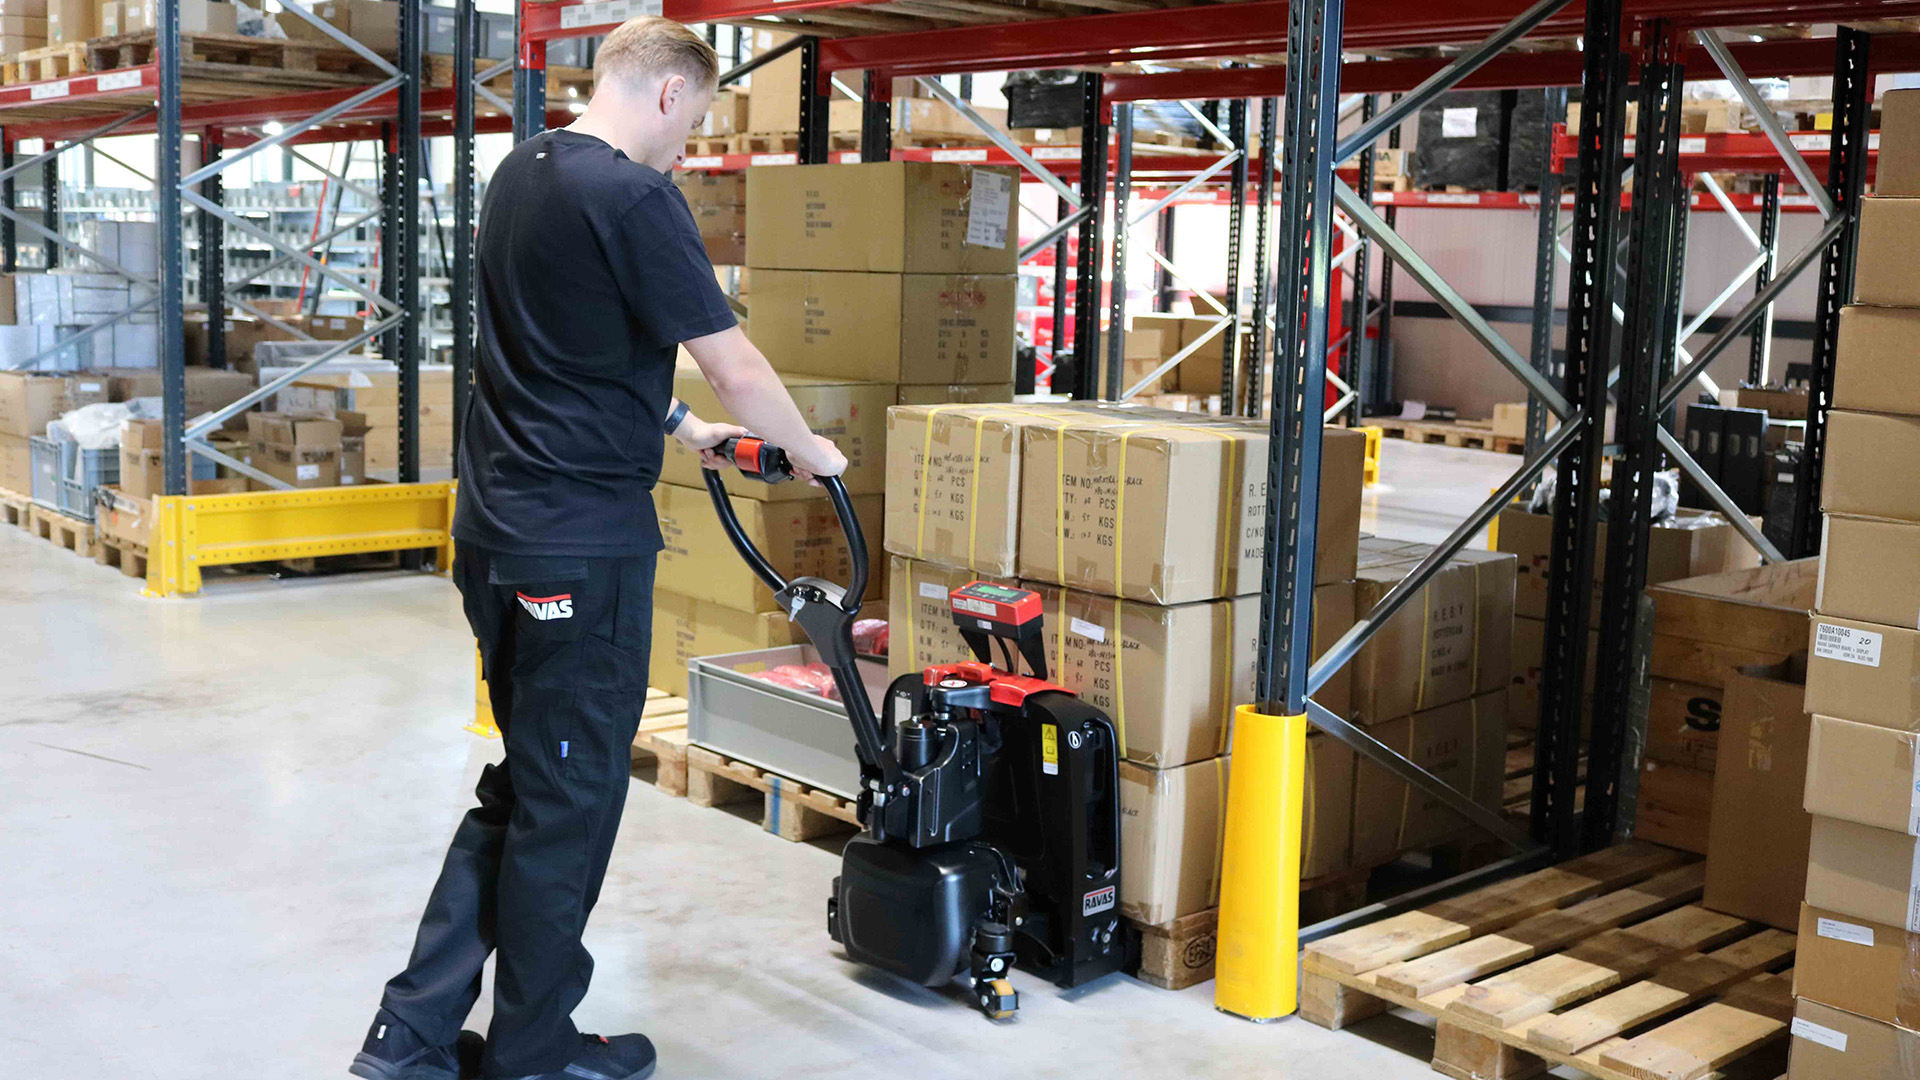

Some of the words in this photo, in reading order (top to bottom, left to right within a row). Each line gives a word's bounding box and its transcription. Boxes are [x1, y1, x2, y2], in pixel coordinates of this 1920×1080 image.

[951, 476, 965, 488] PCS
[1062, 474, 1077, 487] TEM
[950, 493, 965, 504] KGS
[1063, 492, 1077, 504] 'TY:
[1099, 497, 1116, 510] PCS
[949, 509, 964, 521] KGS
[1098, 516, 1115, 529] KGS
[1096, 533, 1113, 547] KGS
[920, 603, 938, 616] ITEM
[1051, 633, 1072, 647] ITM
[1858, 637, 1872, 645] 20
[1050, 650, 1071, 664] Q'Y:
[1094, 659, 1111, 673] PCS
[1093, 677, 1110, 690] KGS
[1093, 694, 1110, 708] KGS
[1685, 697, 1722, 732] S
[1084, 891, 1114, 911] RAVAS
